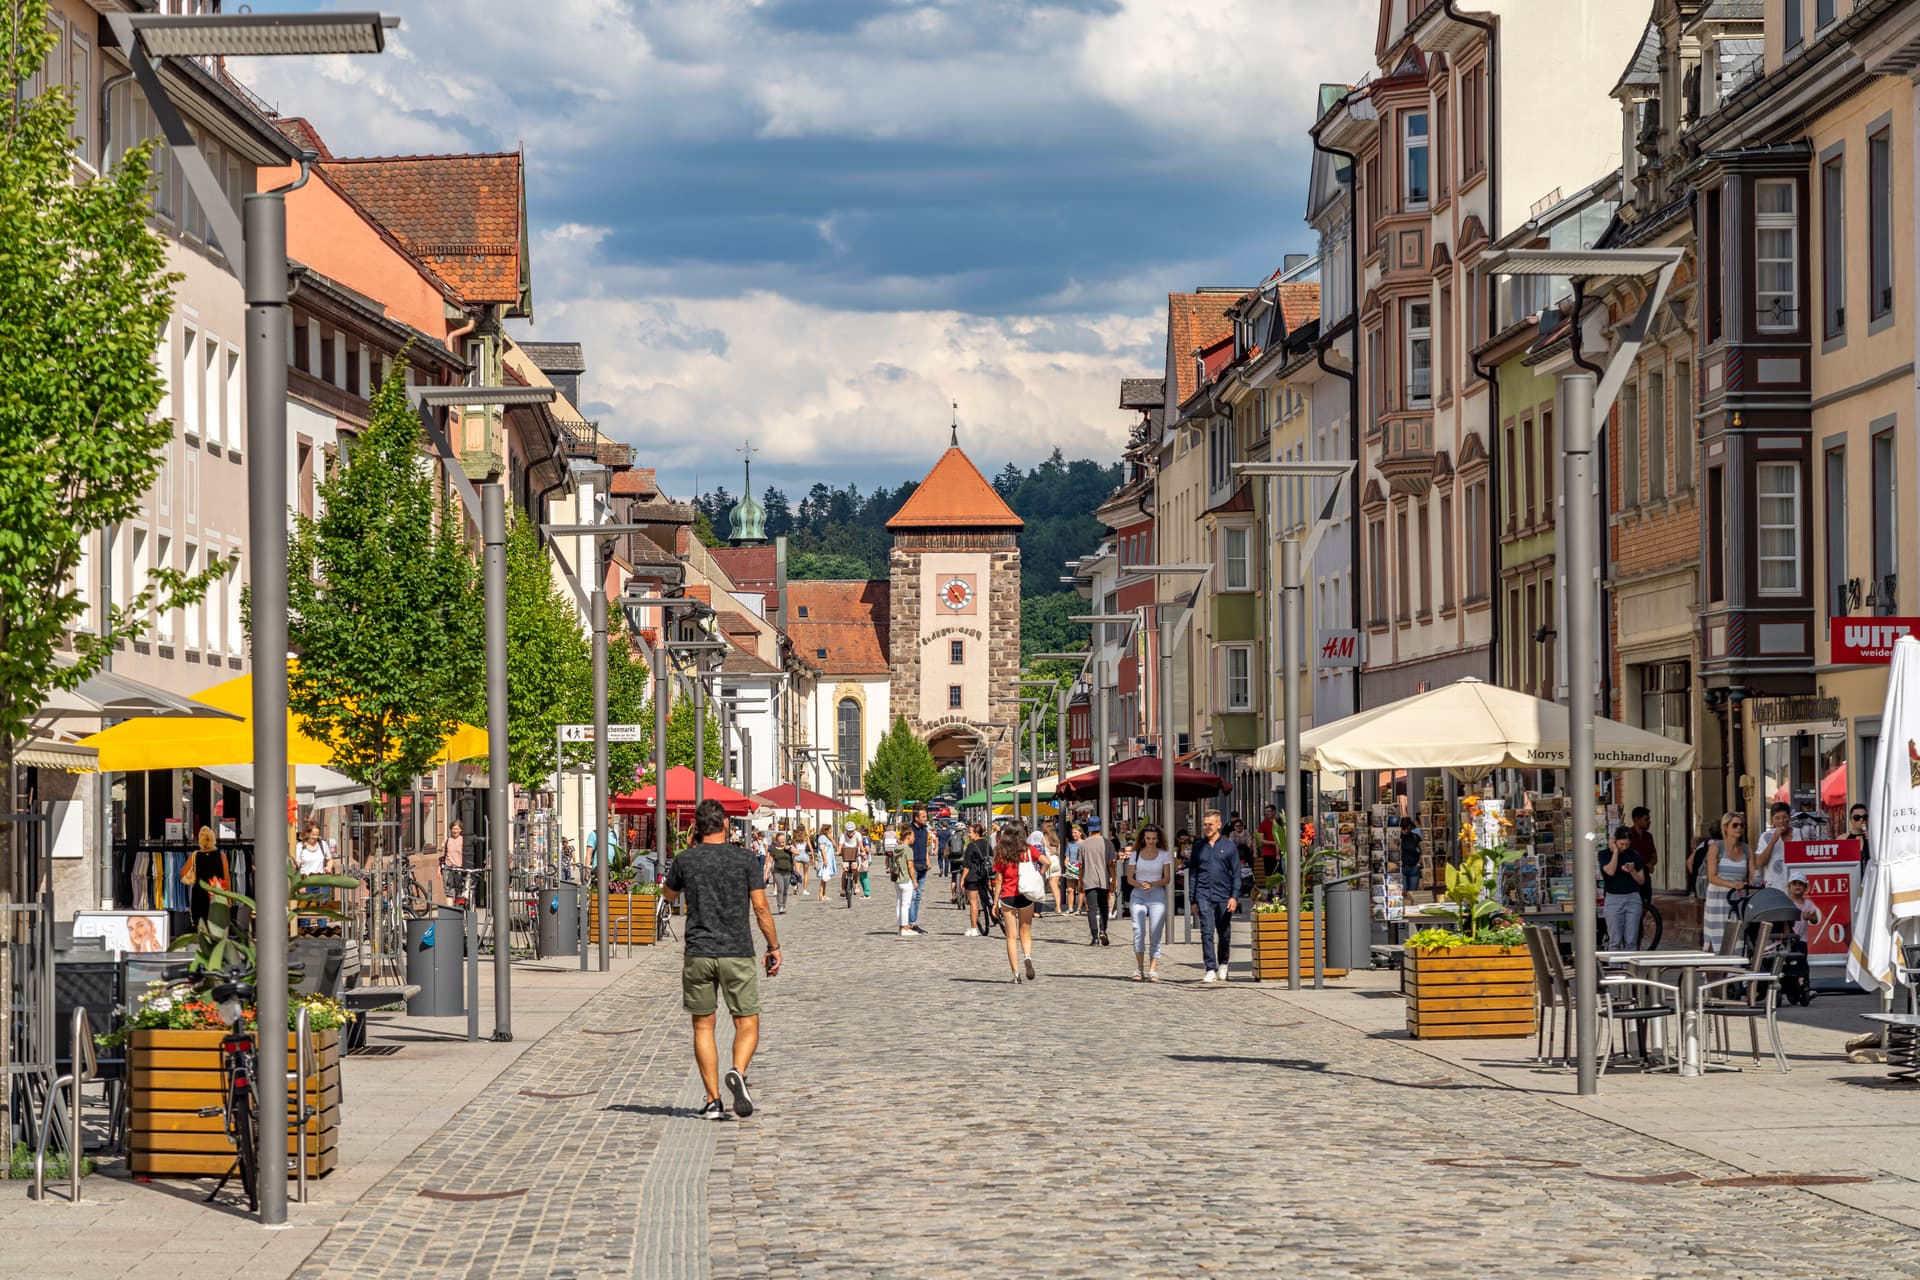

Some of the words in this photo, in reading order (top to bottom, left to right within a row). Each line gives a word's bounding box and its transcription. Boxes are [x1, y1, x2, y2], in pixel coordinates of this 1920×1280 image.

[1844, 625, 1911, 648] WITT
[1321, 636, 1355, 660] H&M
[1527, 749, 1564, 763] Morys
[1568, 749, 1679, 765] uchhandlung
[1805, 844, 1839, 856] WITT
[1805, 878, 1849, 894] ALE
